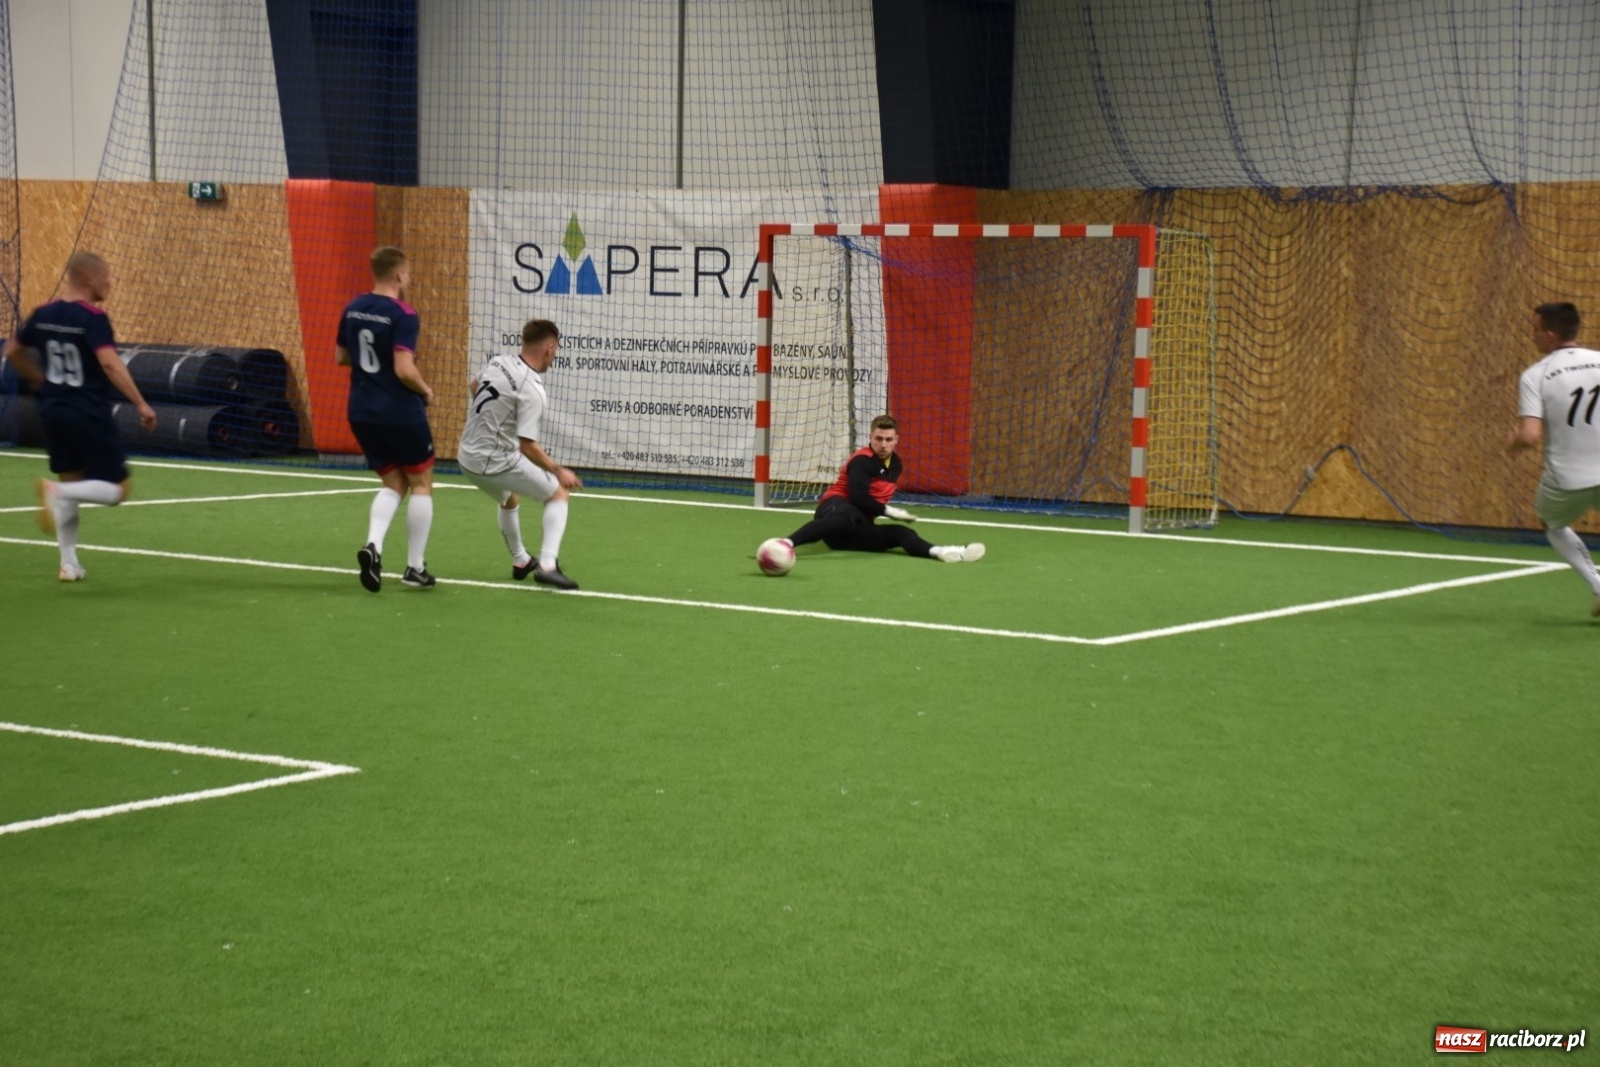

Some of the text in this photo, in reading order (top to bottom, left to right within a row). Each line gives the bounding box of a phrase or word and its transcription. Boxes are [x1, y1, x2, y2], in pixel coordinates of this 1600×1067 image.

[792, 286, 845, 302] s.r.o.
[358, 328, 380, 374] 6
[605, 338, 611, 350] A
[613, 337, 690, 354] DEZINFEKČNÍCH
[818, 345, 847, 359] SAUN
[46, 340, 84, 388] 69
[576, 356, 631, 371] SPORTOVNÍ
[632, 360, 658, 375] HALY,
[660, 360, 741, 376] POTRAVINÁŘSKÉ
[743, 364, 750, 376] A
[590, 399, 754, 420] SERVIS A ODBORNÉ PORADENSTVÍ
[1567, 384, 1600, 427] 11
